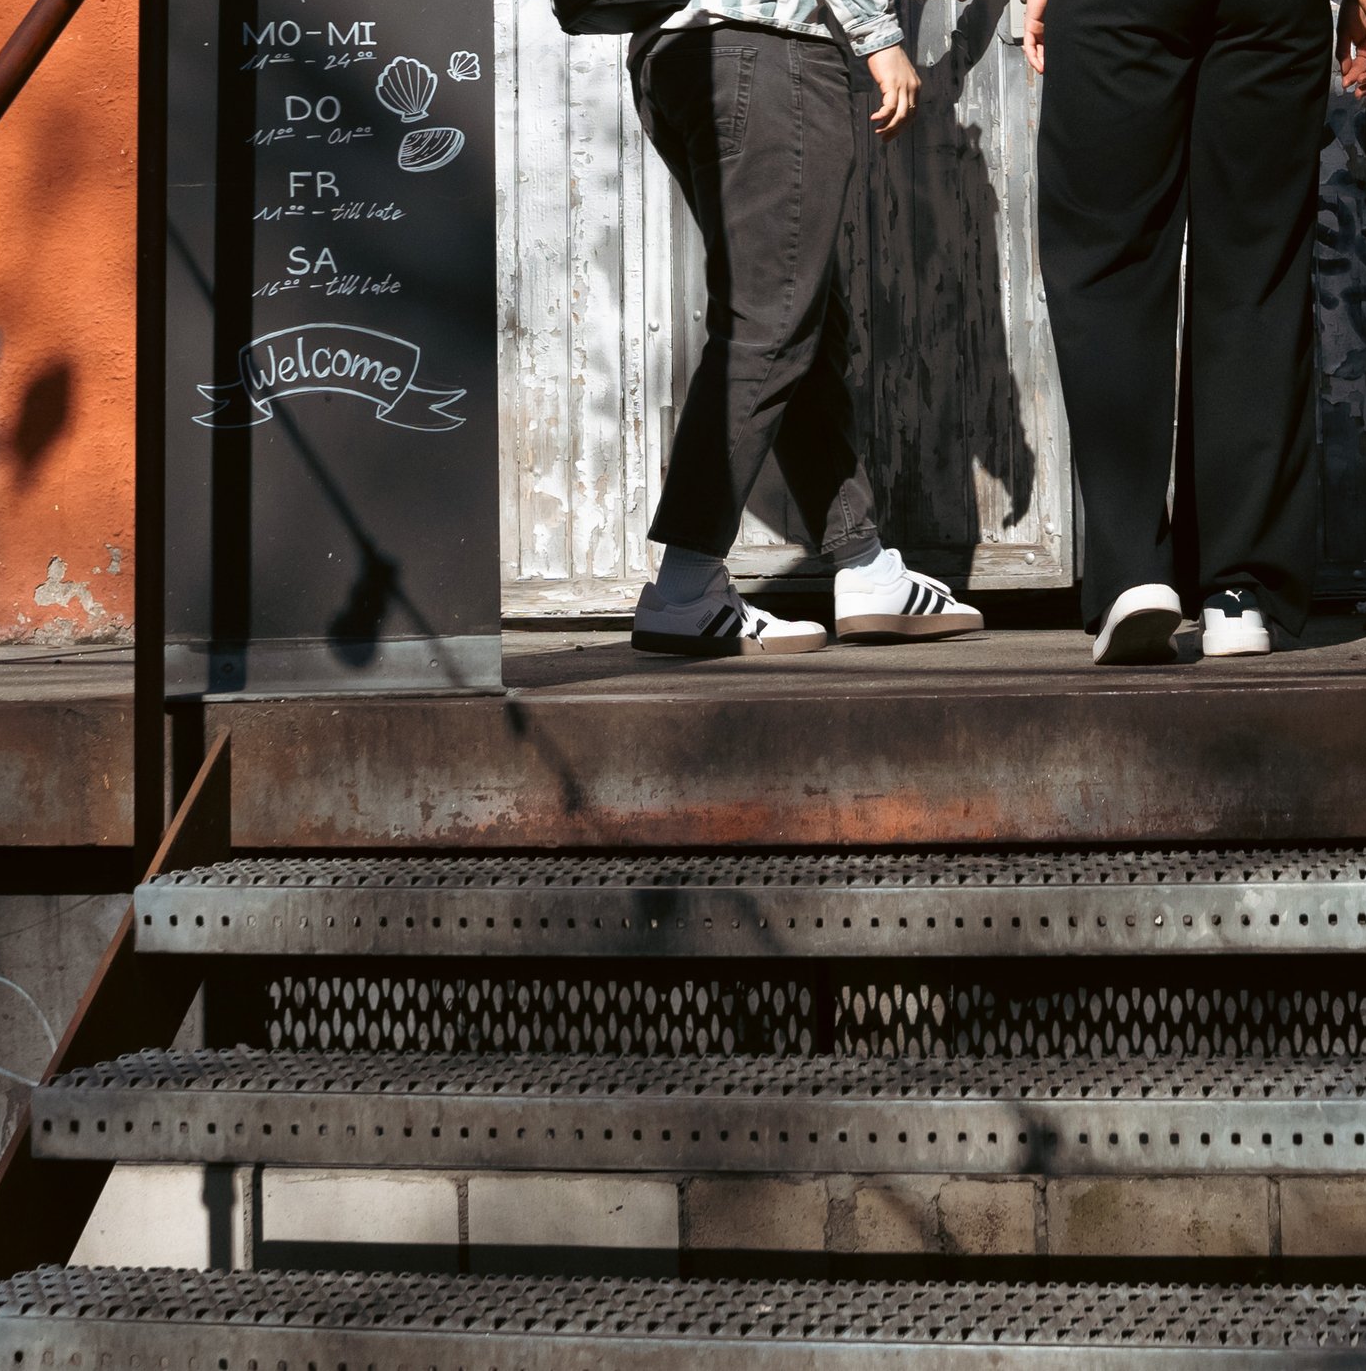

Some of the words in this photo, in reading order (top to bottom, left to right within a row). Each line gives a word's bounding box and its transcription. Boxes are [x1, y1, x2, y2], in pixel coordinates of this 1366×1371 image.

[242, 20, 378, 47] MO-MI
[285, 95, 342, 123] DO
[289, 171, 340, 198] FR
[285, 245, 339, 276] SA
